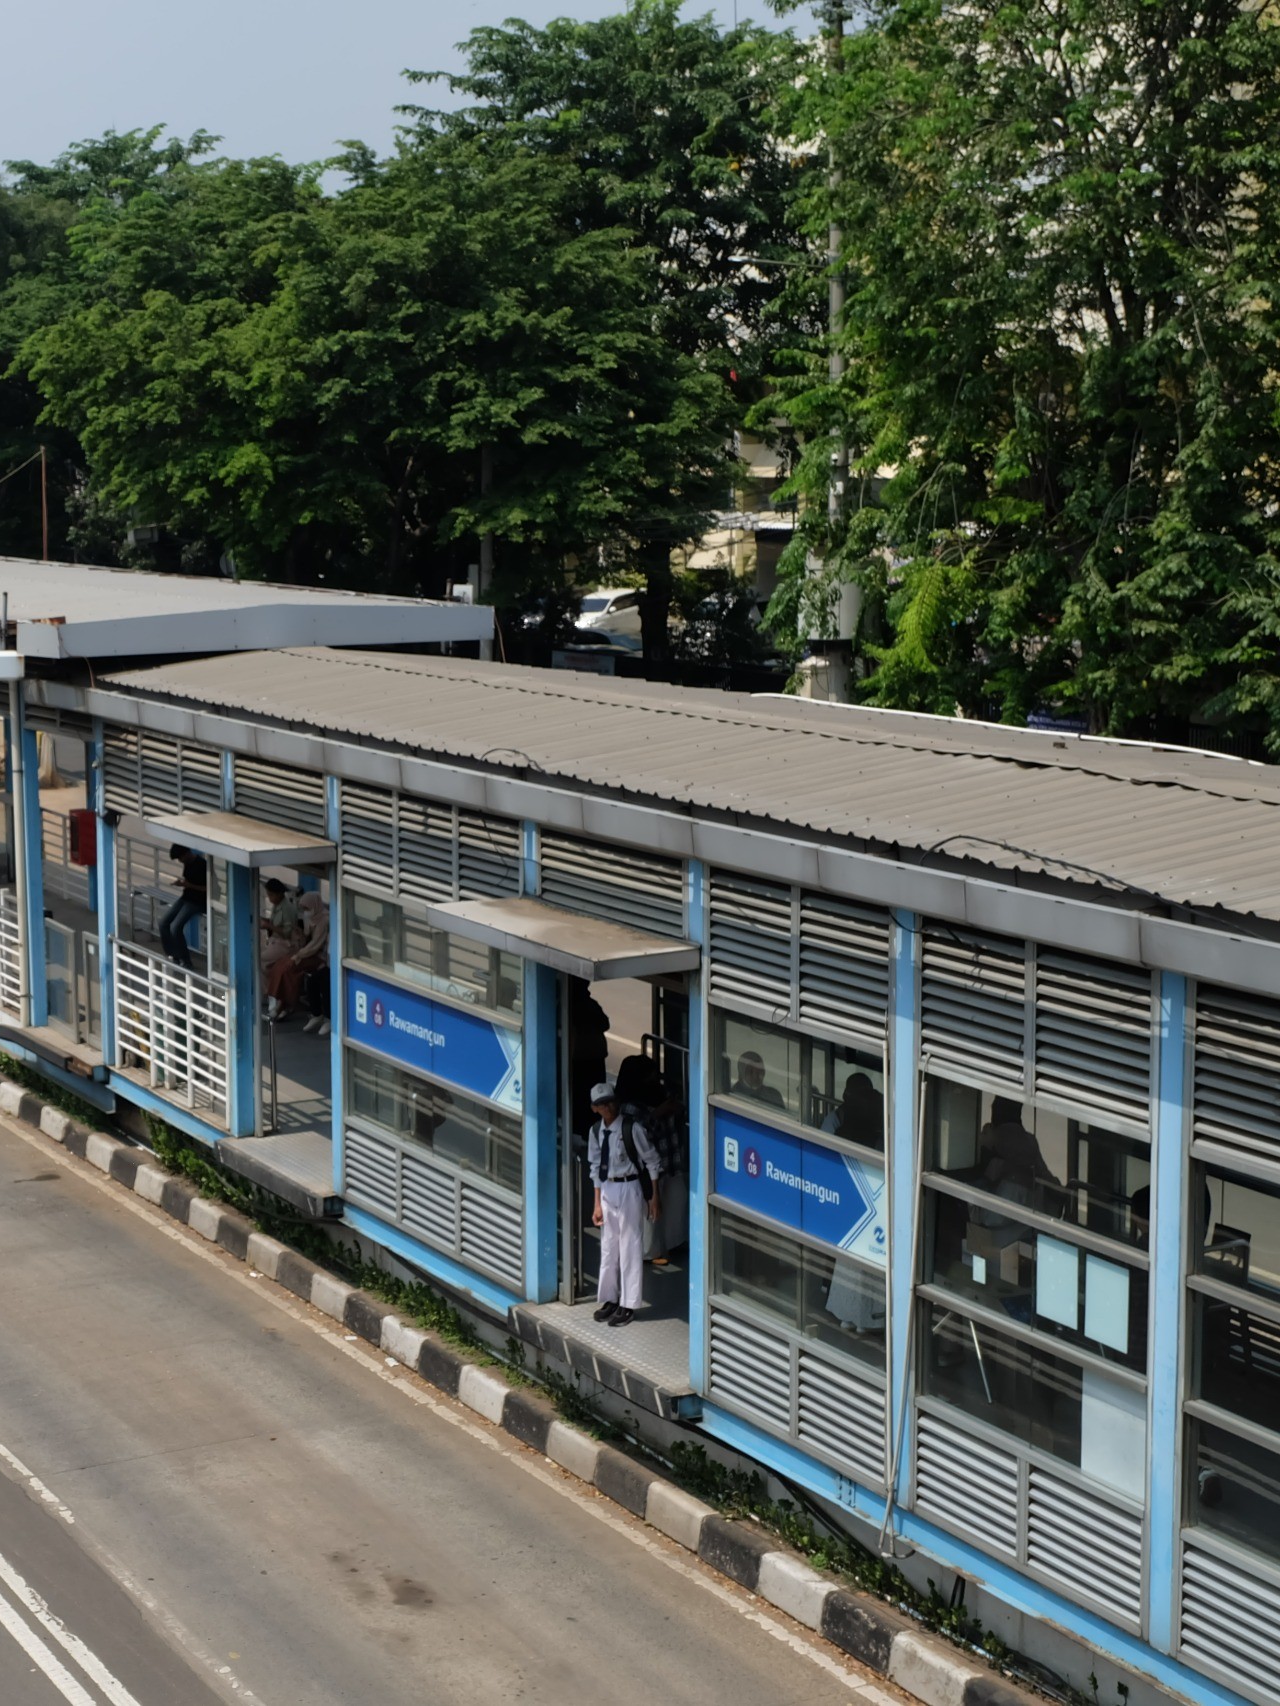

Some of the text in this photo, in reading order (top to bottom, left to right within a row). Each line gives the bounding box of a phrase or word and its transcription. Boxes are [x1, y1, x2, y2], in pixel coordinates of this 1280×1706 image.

[389, 1010, 445, 1047] Rawamangun
[748, 1163, 757, 1175] 08
[750, 1152, 755, 1162] 4
[766, 1161, 840, 1205] Rawamangun
